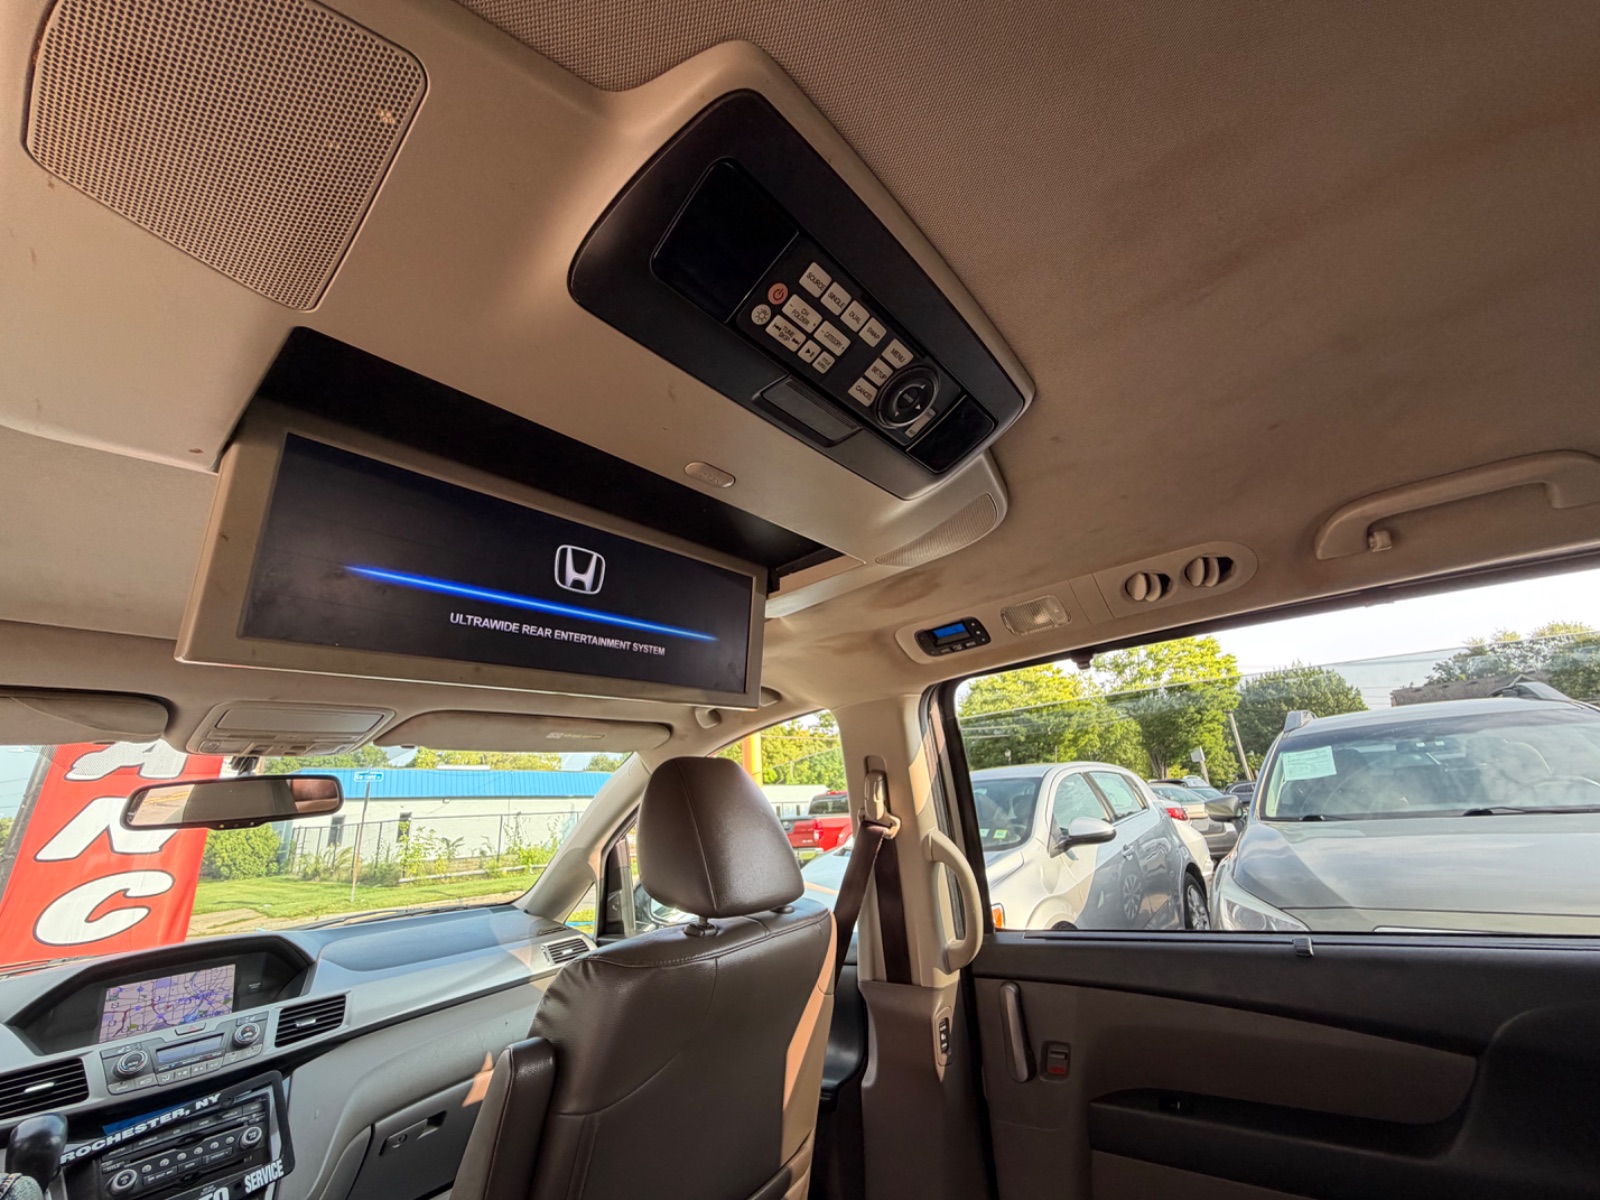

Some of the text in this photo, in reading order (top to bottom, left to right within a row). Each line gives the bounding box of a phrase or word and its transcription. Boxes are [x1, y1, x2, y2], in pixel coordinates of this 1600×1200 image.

[806, 272, 826, 291] SOURCE
[828, 291, 845, 309] SINGLE
[791, 309, 810, 326] FOLDER
[800, 308, 810, 317] CH
[848, 310, 862, 324] DUAL
[890, 348, 906, 363] MENU
[871, 366, 887, 381] SETUP
[855, 384, 874, 401] CANCEL
[449, 611, 666, 656] ULTRAWIDE REAR ENTERTAINMENT SYSTEM
[60, 1093, 221, 1164] ROCHESTER, NY
[244, 1159, 285, 1193] SERVICE
